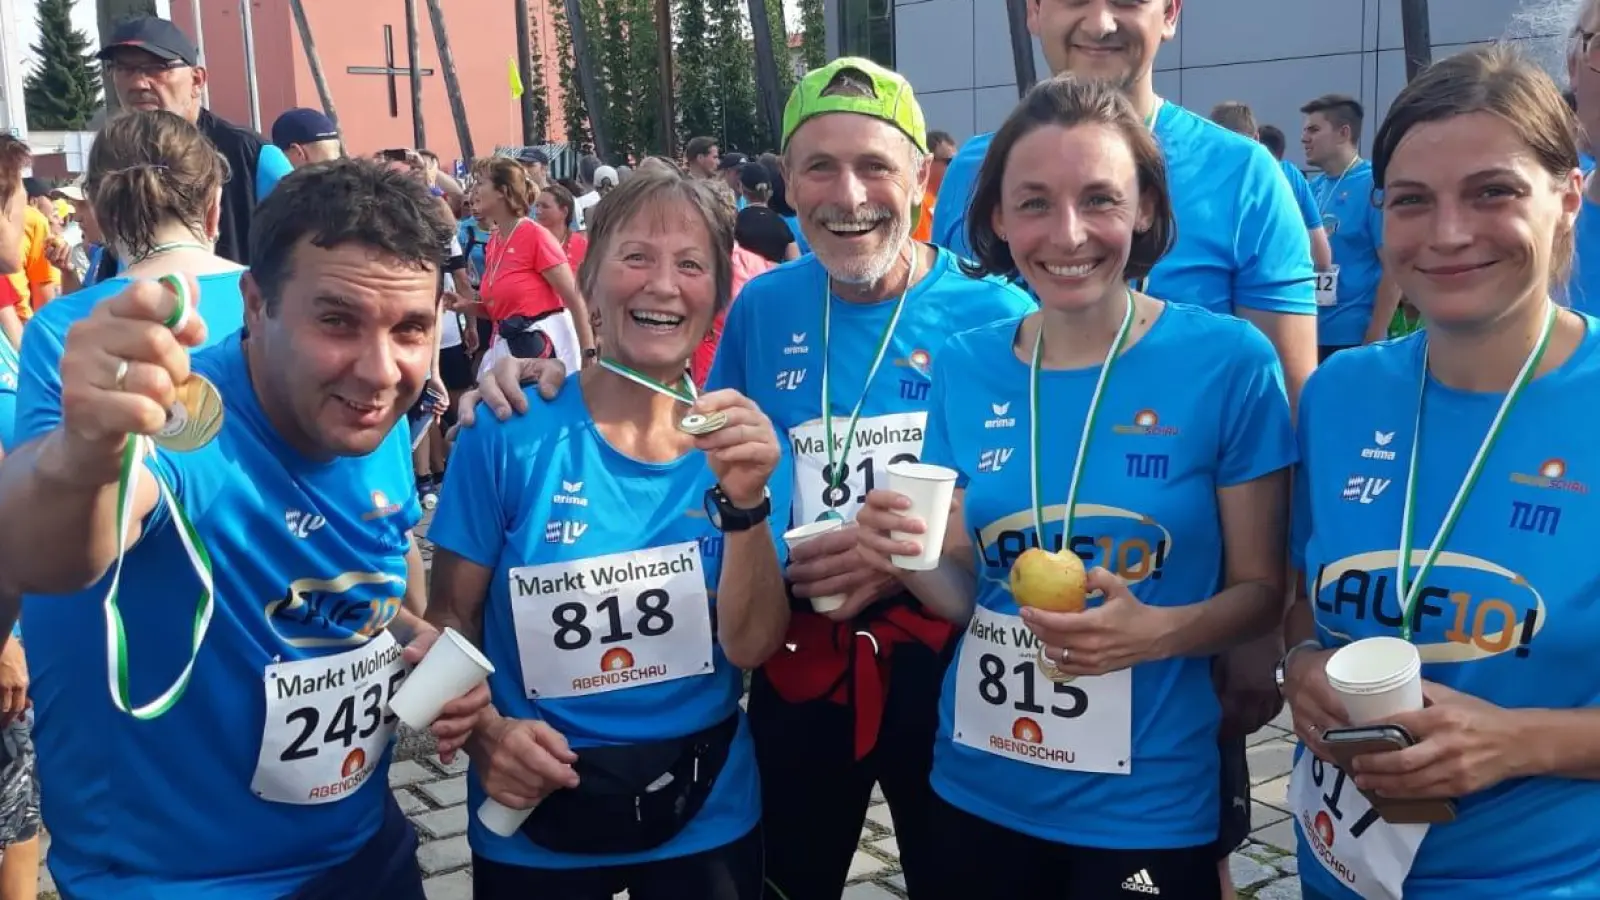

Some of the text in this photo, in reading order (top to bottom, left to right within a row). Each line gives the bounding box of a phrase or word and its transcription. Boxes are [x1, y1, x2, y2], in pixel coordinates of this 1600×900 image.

[855, 425, 923, 449] Wolnza
[1125, 453, 1170, 480] TUM
[1361, 447, 1397, 461] erima
[822, 453, 920, 508] 81
[553, 494, 588, 507] erima
[1509, 500, 1561, 536] TUM
[517, 553, 694, 598] Markt Wolnzach
[551, 588, 674, 650] 818
[970, 615, 1007, 646] Markt
[276, 668, 345, 700] Markt
[572, 664, 667, 690] ABENDSCHAU
[979, 653, 1089, 719] 815
[989, 735, 1076, 764] ABENDSCHAU
[1121, 881, 1160, 895] adidas
